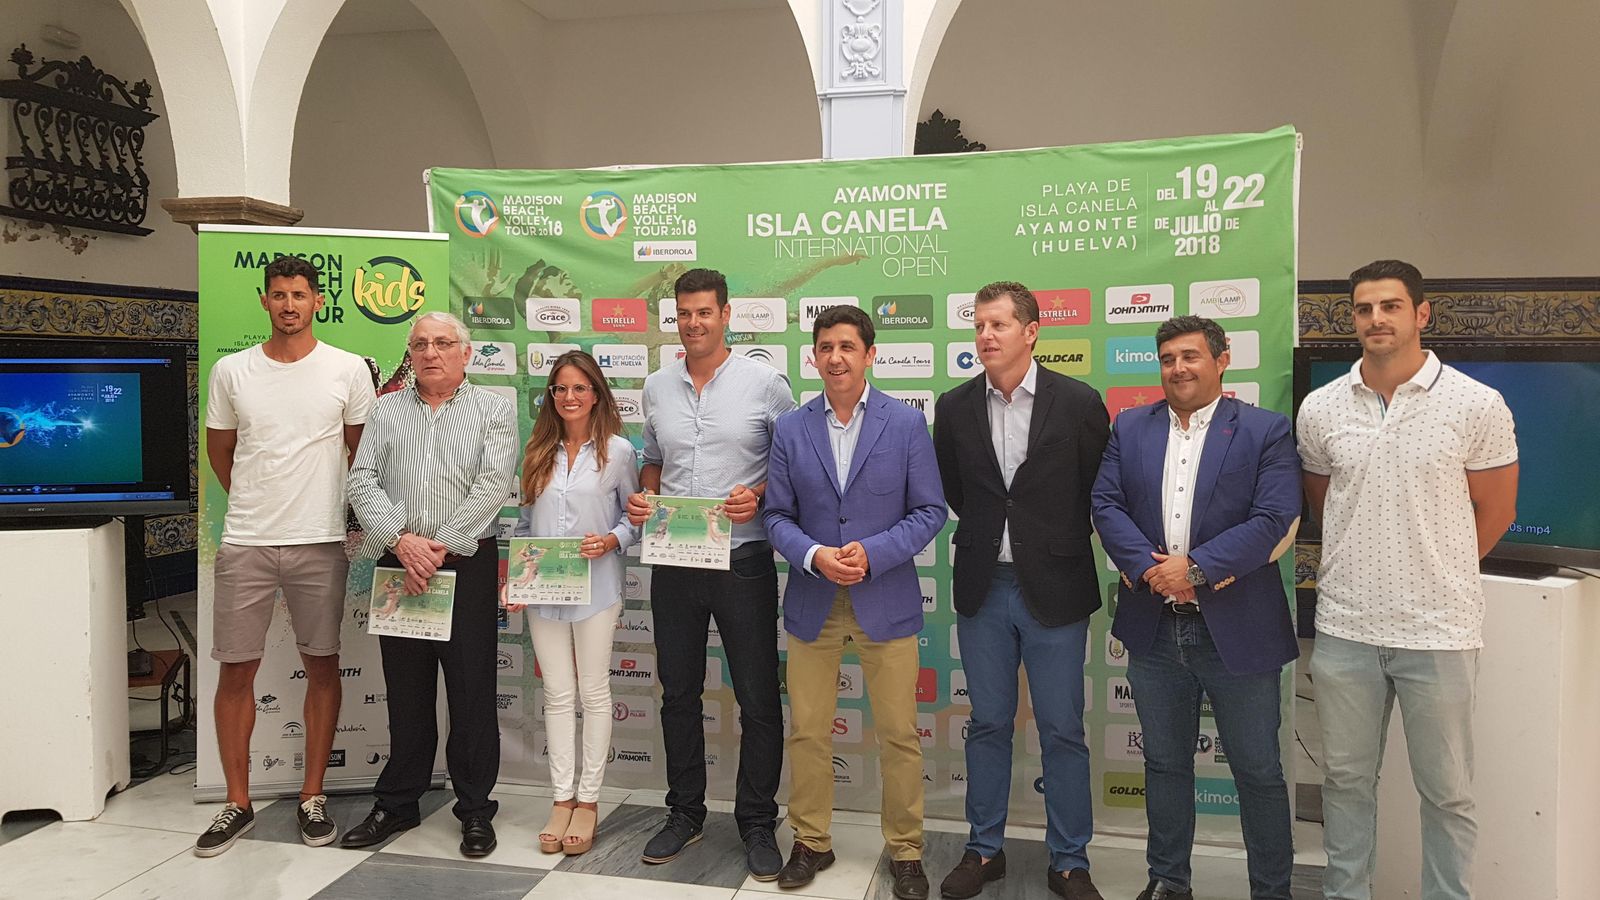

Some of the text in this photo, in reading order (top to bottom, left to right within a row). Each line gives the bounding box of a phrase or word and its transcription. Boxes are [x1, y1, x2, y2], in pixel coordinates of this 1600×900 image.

[1042, 178, 1131, 198] PLAYA DE
[1156, 163, 1218, 201] DEL 19
[632, 192, 697, 203] MADISON
[833, 183, 947, 204] AYAMONTE
[1204, 173, 1265, 213] AL 22
[502, 195, 562, 205] MADISON
[503, 205, 544, 215] BEACH
[632, 204, 677, 214] BEACH
[1021, 197, 1138, 218] ISLA CANELA
[504, 215, 549, 226] VOLLEY
[633, 214, 682, 225] VOLLEY
[747, 206, 948, 237] ISLA CANELA
[1154, 213, 1239, 236] DE JULIO DE
[505, 226, 537, 236] TOUR
[633, 225, 669, 236] TOUR
[1015, 216, 1137, 236] AYAMONTE
[774, 234, 948, 258] INTERNATIONAL
[1032, 234, 1137, 256] (HUELVA)
[1174, 235, 1220, 257] 2018
[652, 248, 693, 256] IBERDROLA
[234, 251, 342, 271] MAON
[882, 256, 947, 277] OPEN
[354, 266, 426, 317] kids
[316, 306, 344, 324] UR
[472, 316, 511, 325] IBERDROLA
[540, 313, 567, 321] Grace
[663, 316, 678, 324] JOH
[882, 316, 928, 324] IBERDROLA
[874, 357, 886, 365] Isla
[888, 356, 911, 365] Canela
[1507, 522, 1551, 536] 0s.mp4
[617, 753, 652, 762] AYAMONTE
[1110, 786, 1145, 796] GOLDC
